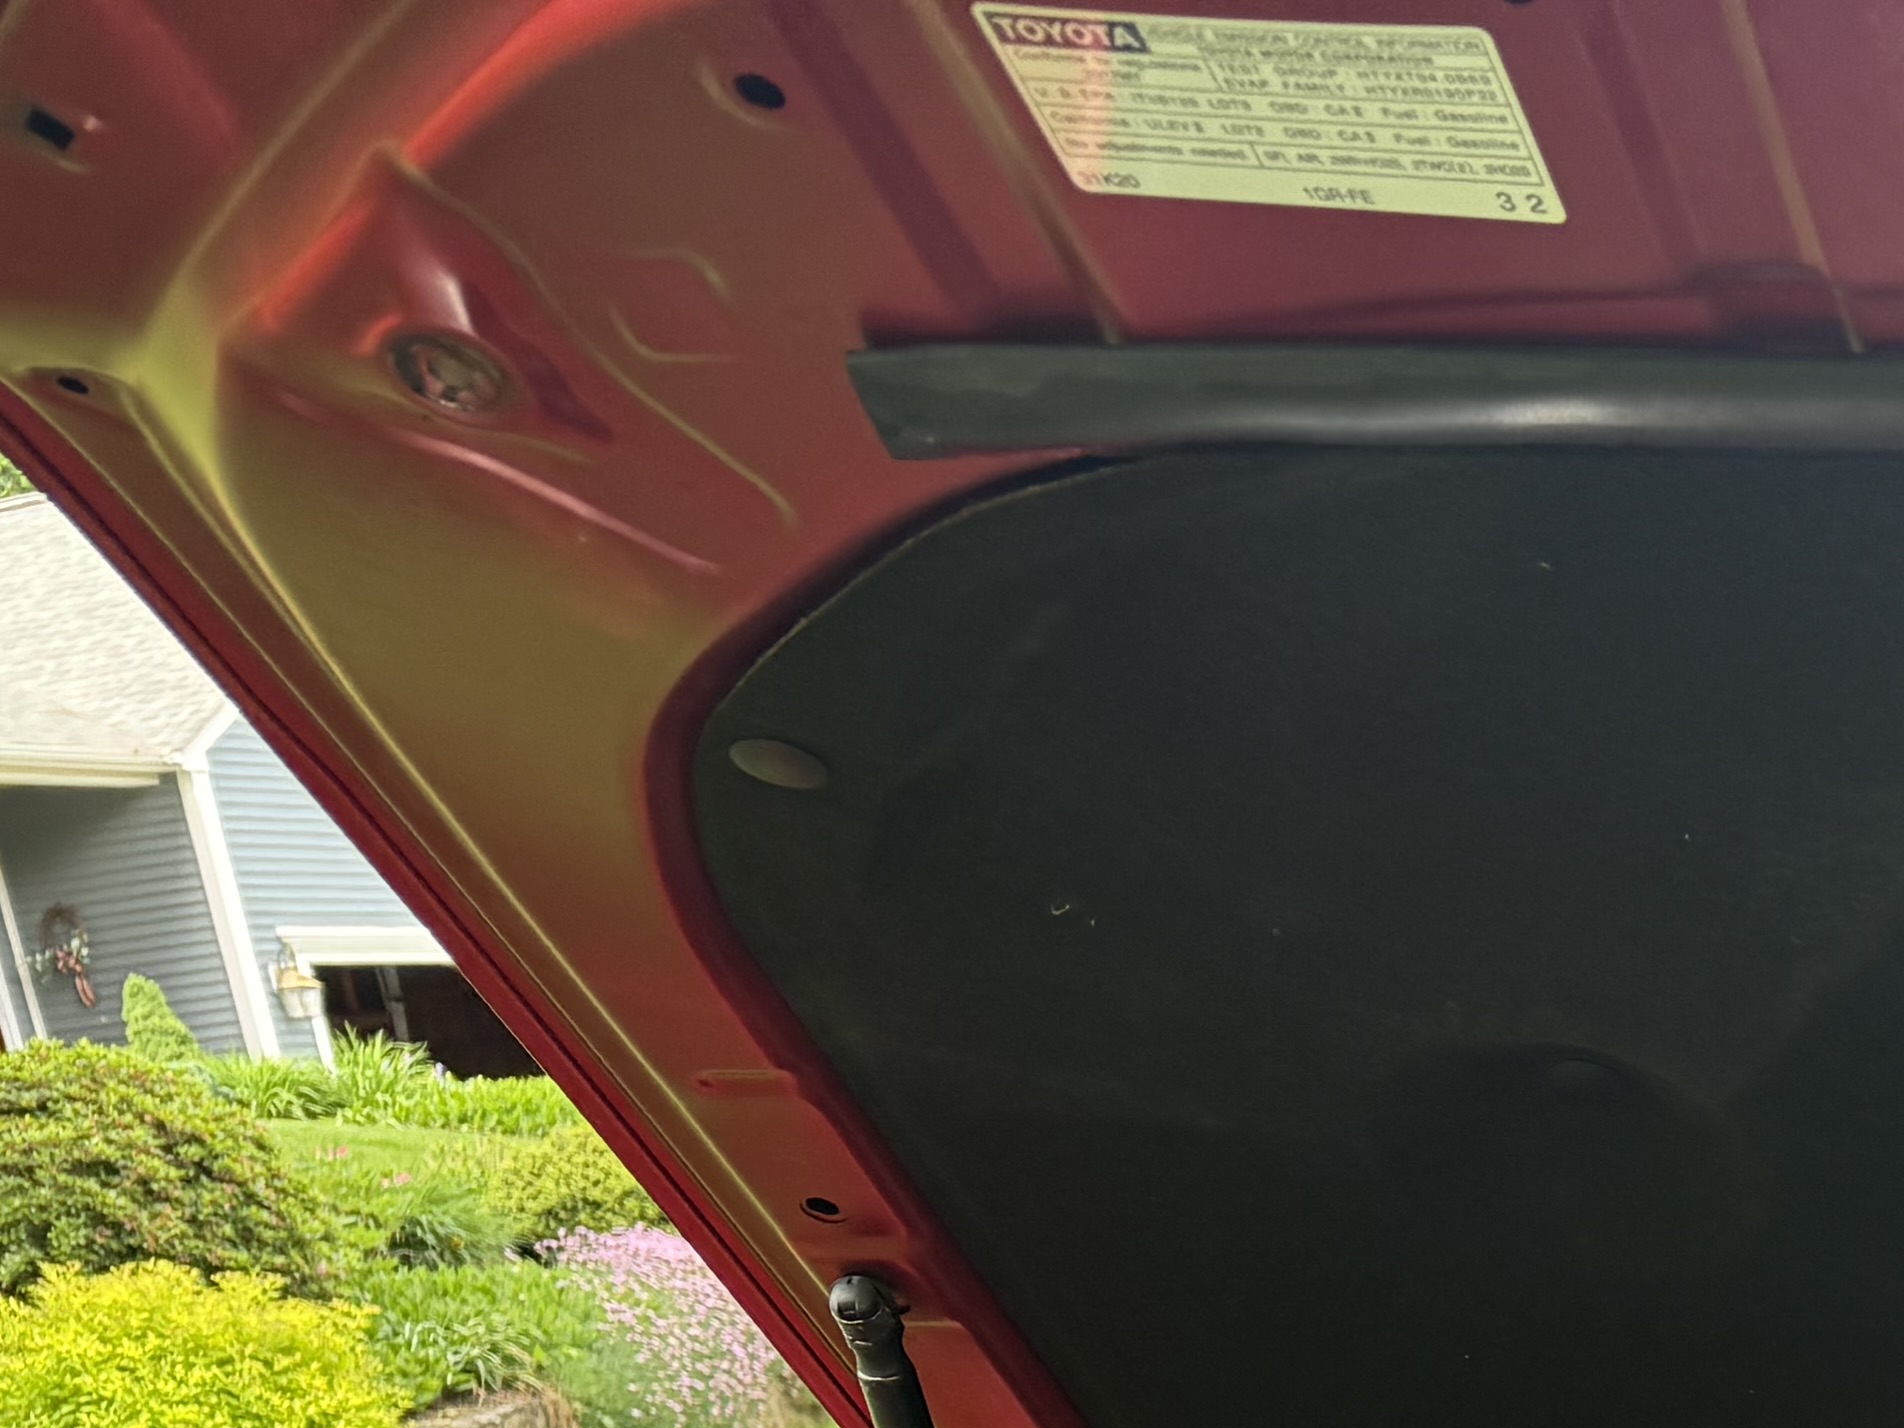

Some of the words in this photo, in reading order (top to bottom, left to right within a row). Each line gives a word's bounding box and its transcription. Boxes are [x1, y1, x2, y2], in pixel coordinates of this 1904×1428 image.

[992, 17, 1143, 48] TOYOTA
[1380, 107, 1419, 121] Fuel
[1434, 109, 1509, 125] Gasoline
[1393, 132, 1432, 147] Fuel
[1446, 135, 1521, 152] Gasoline
